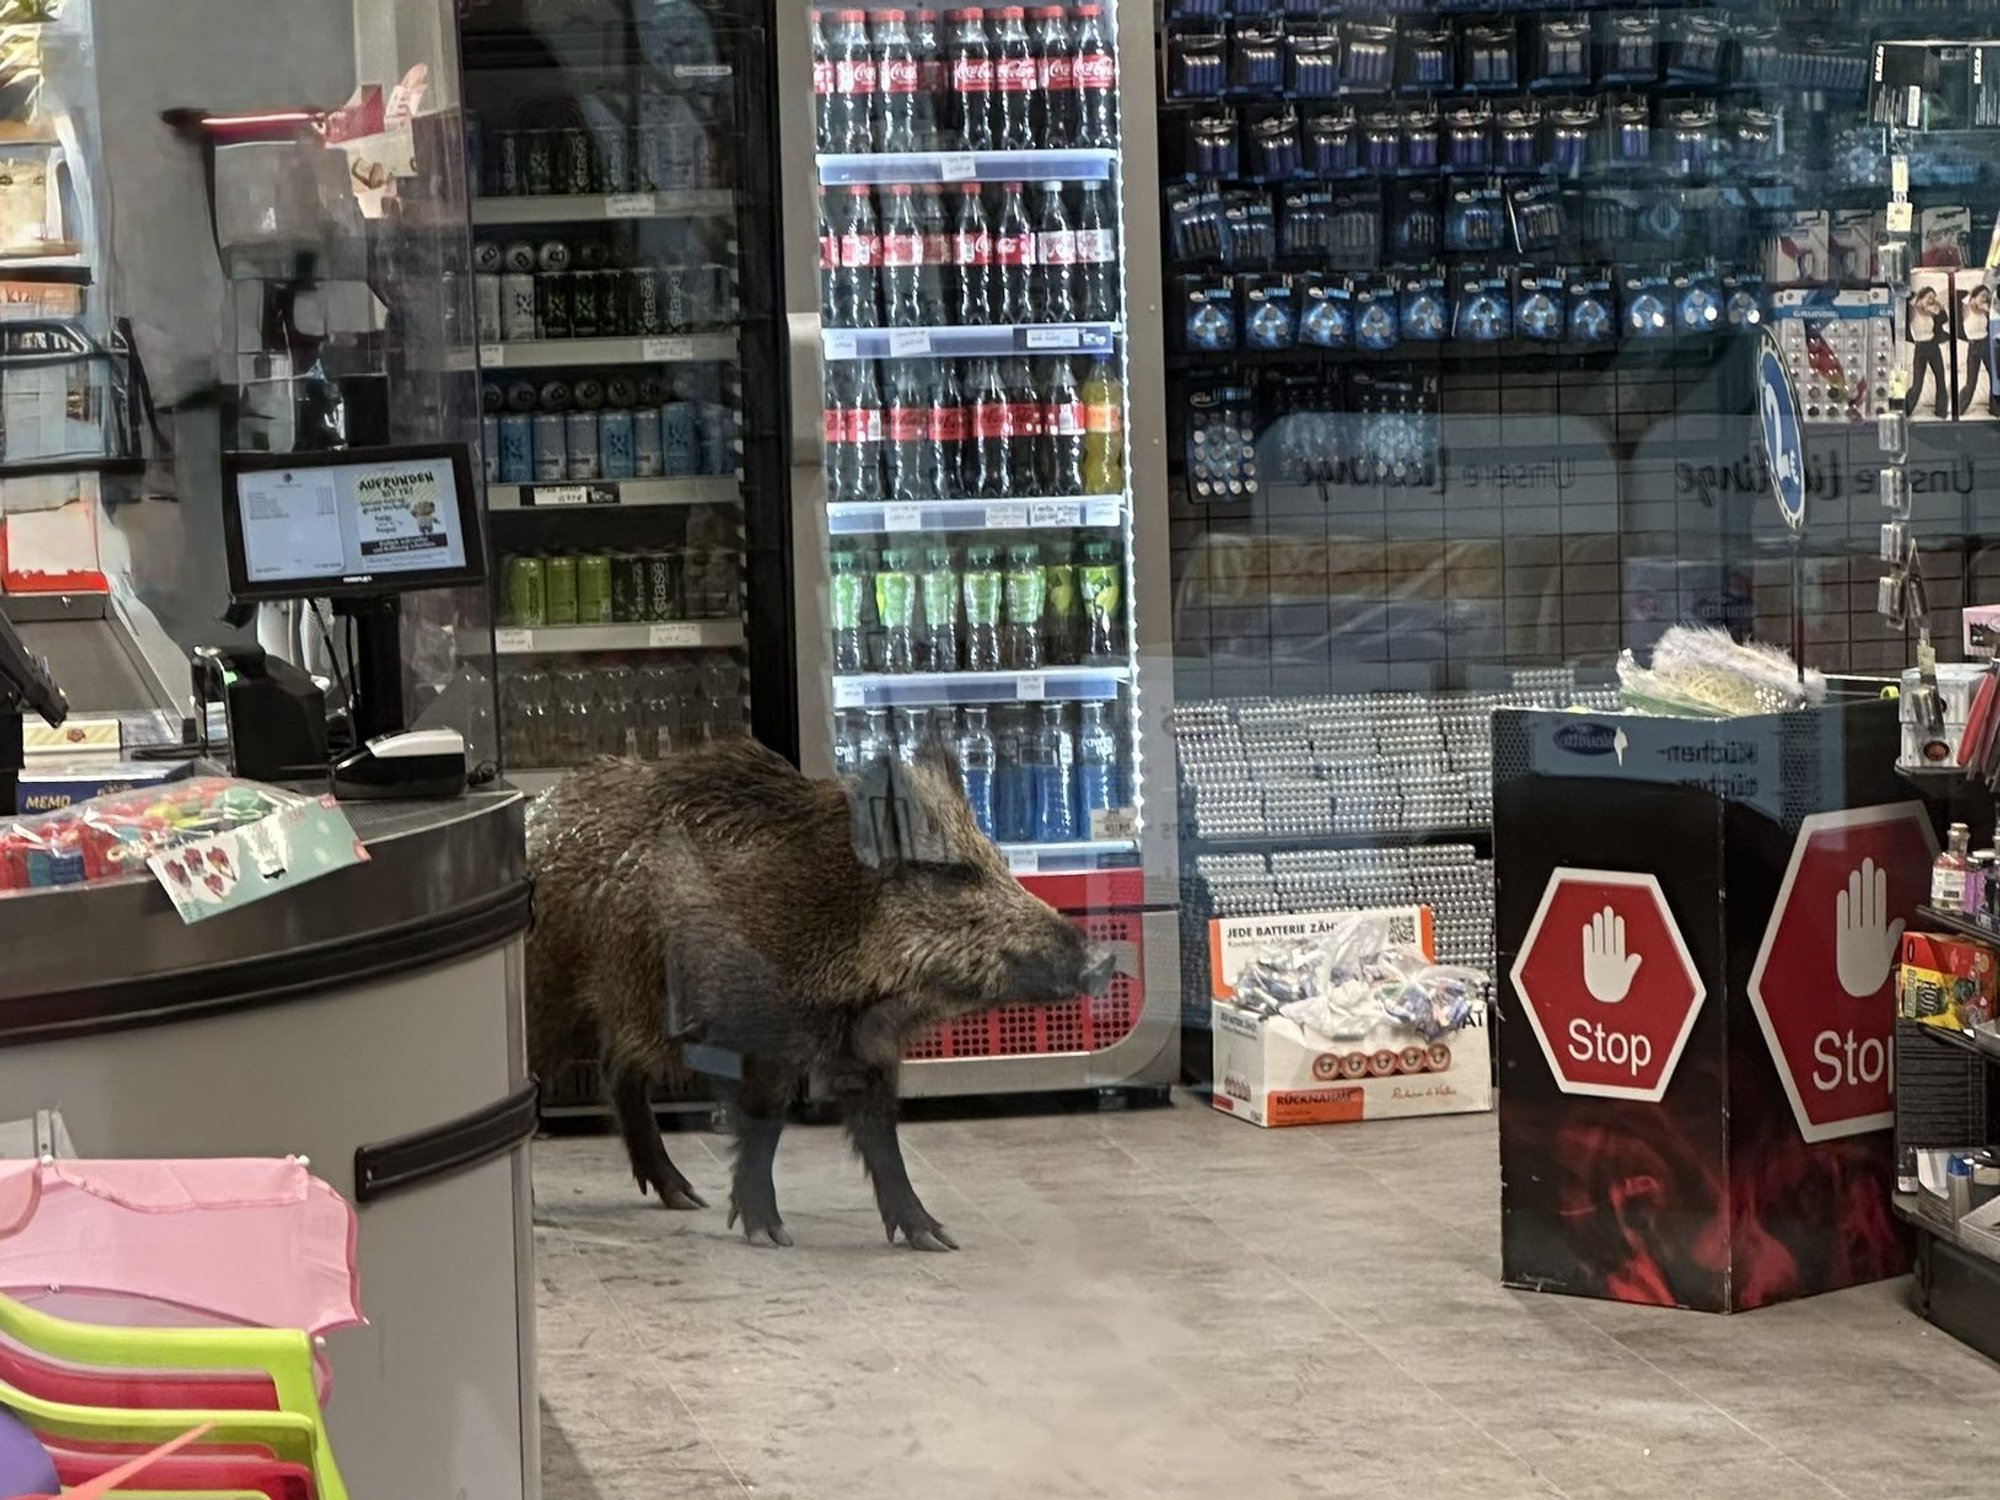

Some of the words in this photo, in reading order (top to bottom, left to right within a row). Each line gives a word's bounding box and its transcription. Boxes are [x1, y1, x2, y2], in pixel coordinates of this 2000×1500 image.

[359, 470, 434, 492] AUFRUNDEN
[1227, 926, 1252, 939] JEDE
[1256, 924, 1306, 937] BATTERIE
[1310, 920, 1338, 934] ZÄH
[1568, 1018, 1652, 1077] Stop
